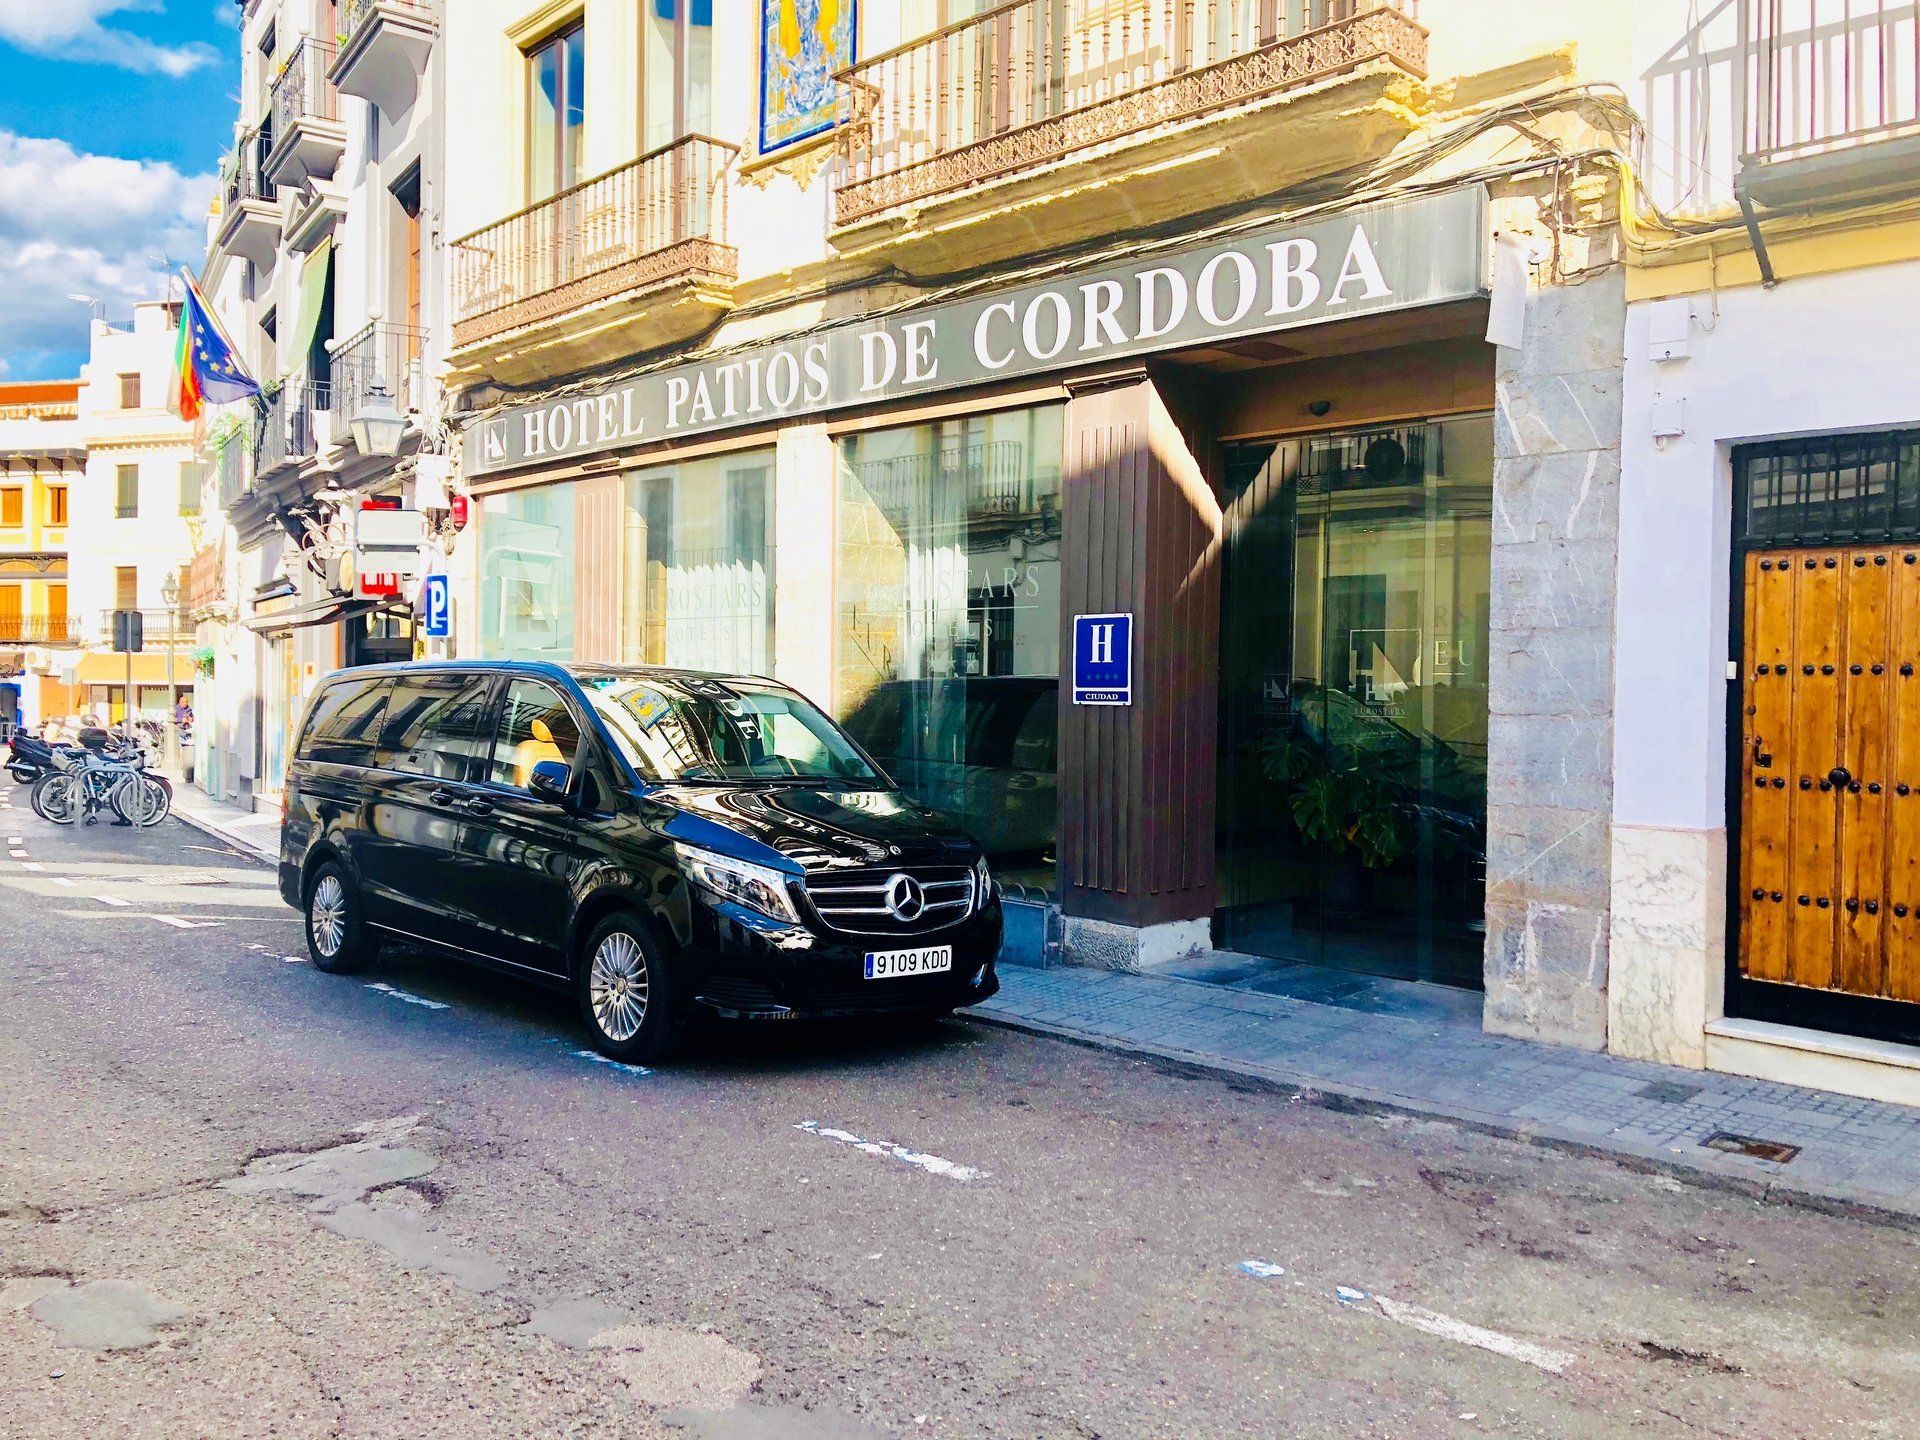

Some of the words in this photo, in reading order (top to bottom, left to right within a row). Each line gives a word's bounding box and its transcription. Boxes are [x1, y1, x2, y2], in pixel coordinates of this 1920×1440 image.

[522, 388, 646, 458] HOTEL
[664, 342, 831, 430] PATIOS
[858, 318, 939, 393] DE
[972, 223, 1394, 371] CORDOBA
[1089, 623, 1115, 663] H
[1085, 693, 1119, 701] CIUDAD
[876, 953, 917, 974] 9109
[921, 949, 949, 971] KDD
